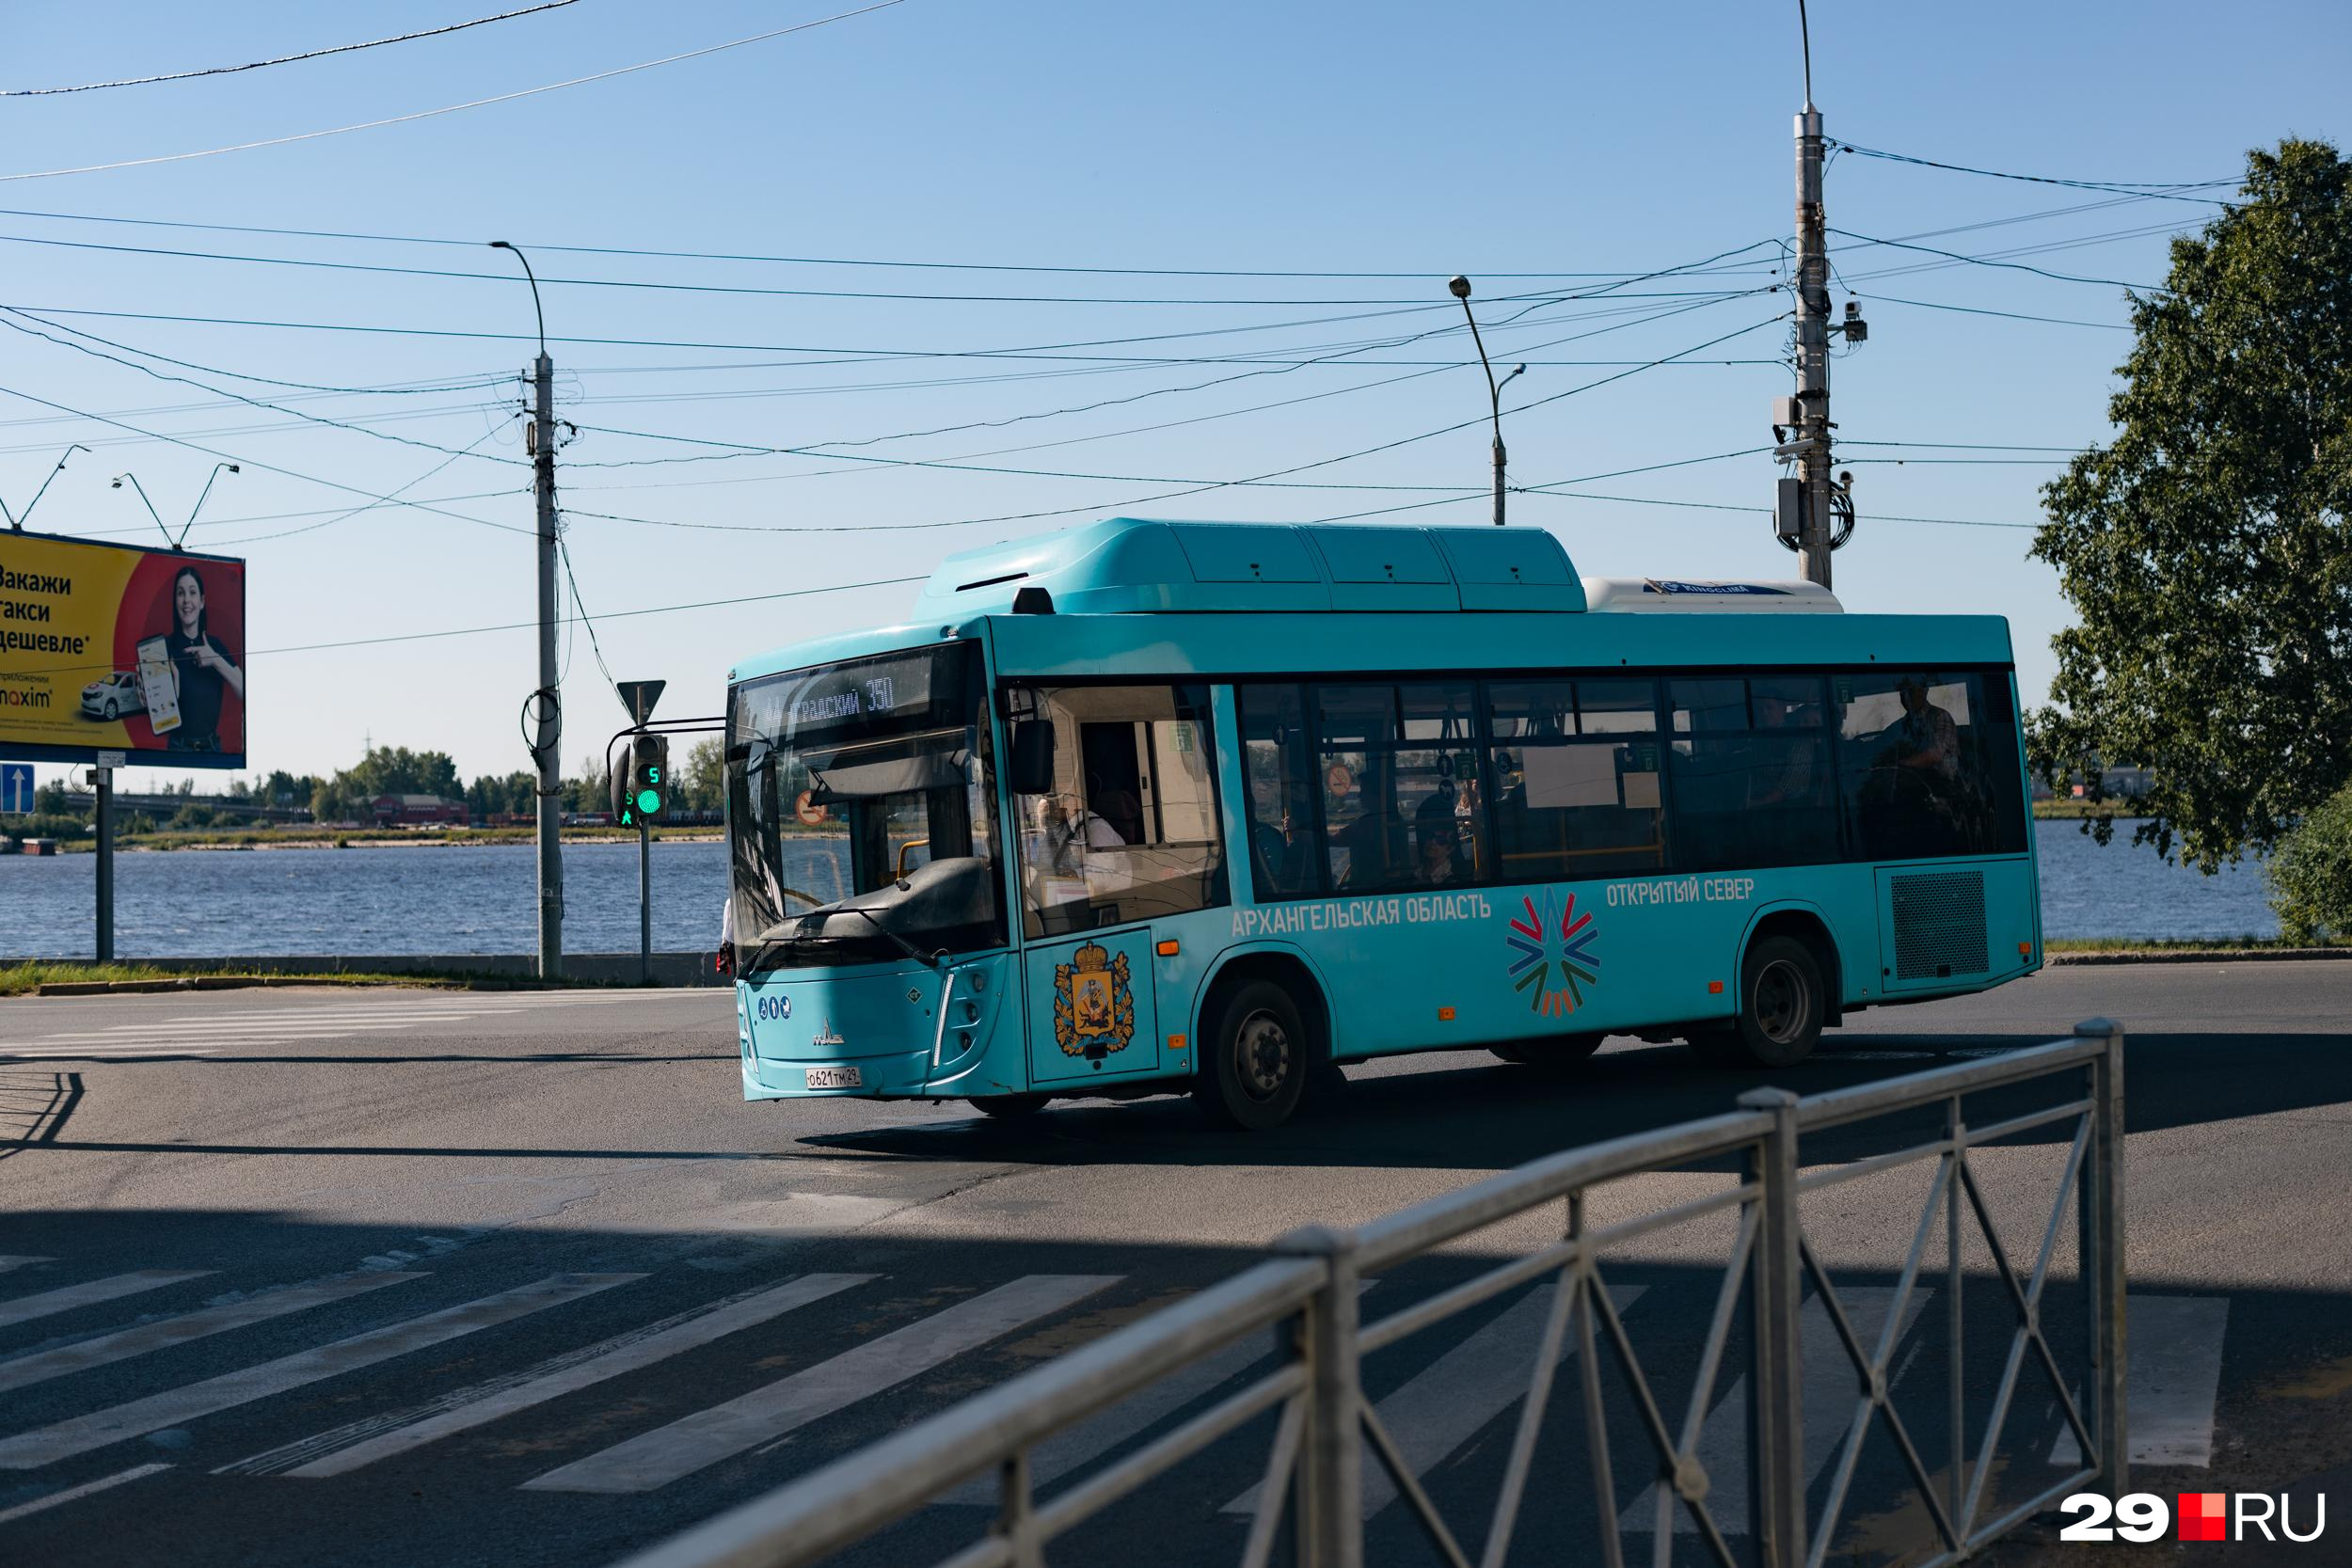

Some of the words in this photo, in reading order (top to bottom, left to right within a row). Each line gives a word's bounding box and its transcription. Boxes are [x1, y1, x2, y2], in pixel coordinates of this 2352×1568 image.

[1682, 583, 1750, 594] KINGCLIMA
[866, 676, 894, 713] 350
[648, 767, 660, 784] 5
[1704, 878, 1755, 901] СЕВЕР
[1232, 898, 1400, 937] АРХАНГЕЛЬСКАЯ
[1406, 895, 1491, 924] ОБЛАСТЬ
